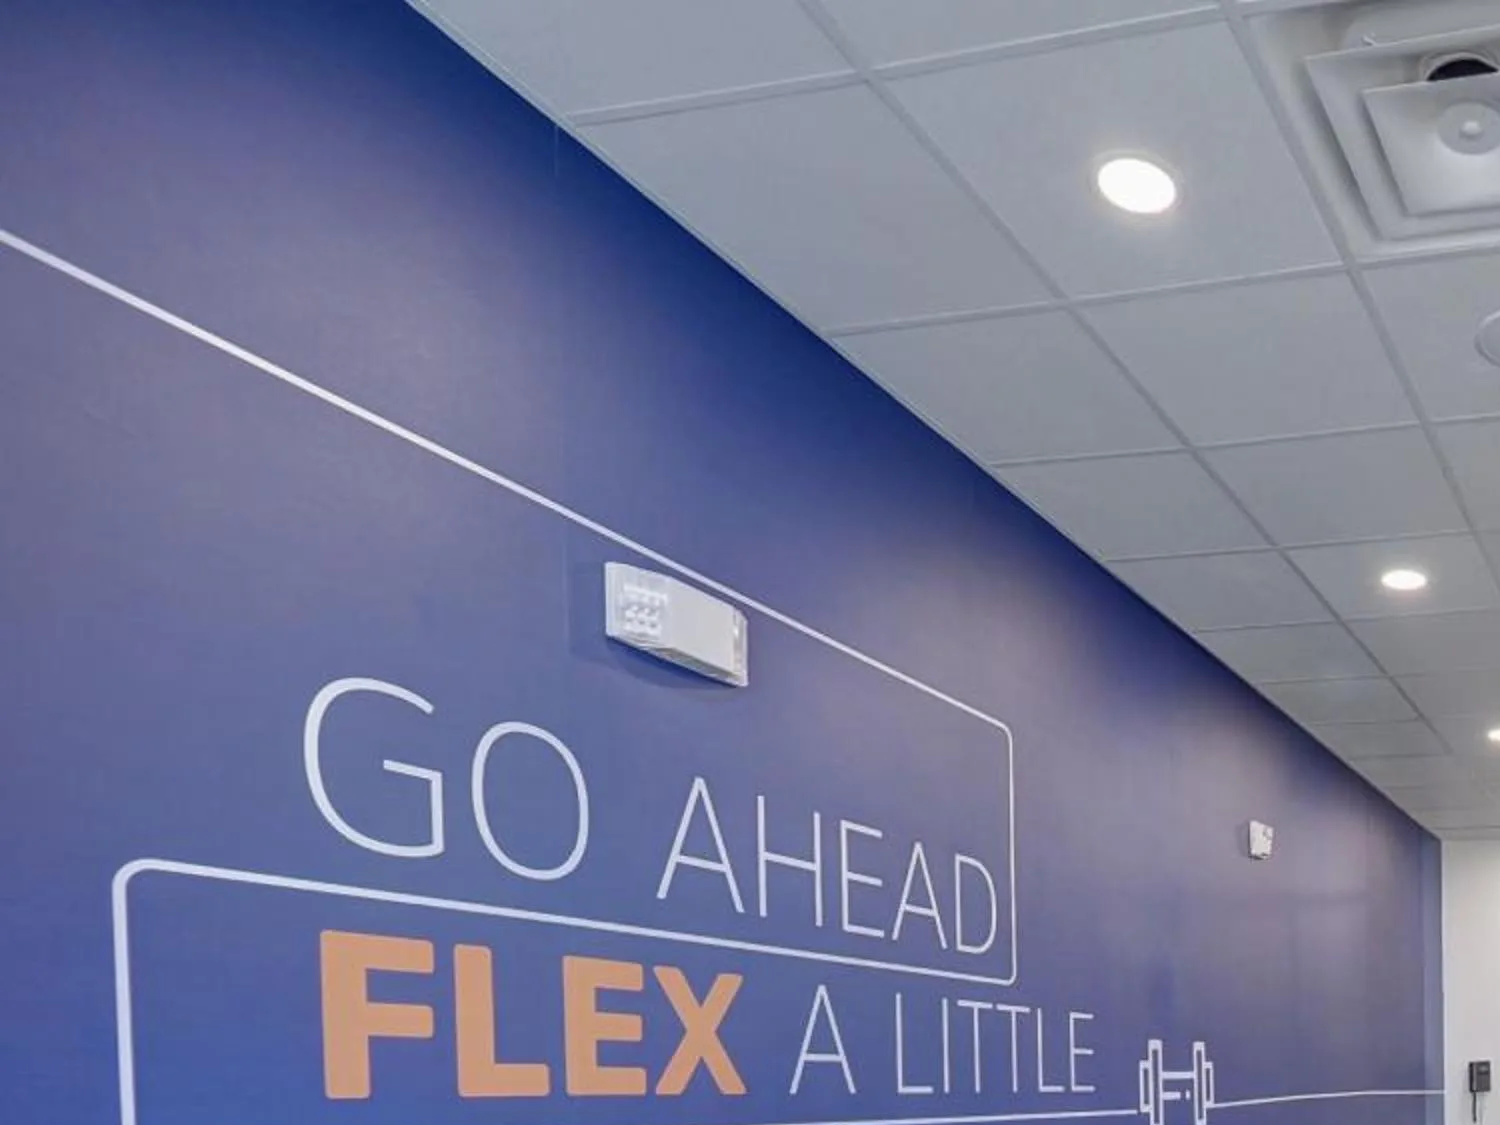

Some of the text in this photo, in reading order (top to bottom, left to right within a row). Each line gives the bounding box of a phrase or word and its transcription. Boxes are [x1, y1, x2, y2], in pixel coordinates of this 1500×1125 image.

[303, 676, 997, 955] GO AHEAD
[319, 928, 1096, 1100] FLEX A LITTLE
